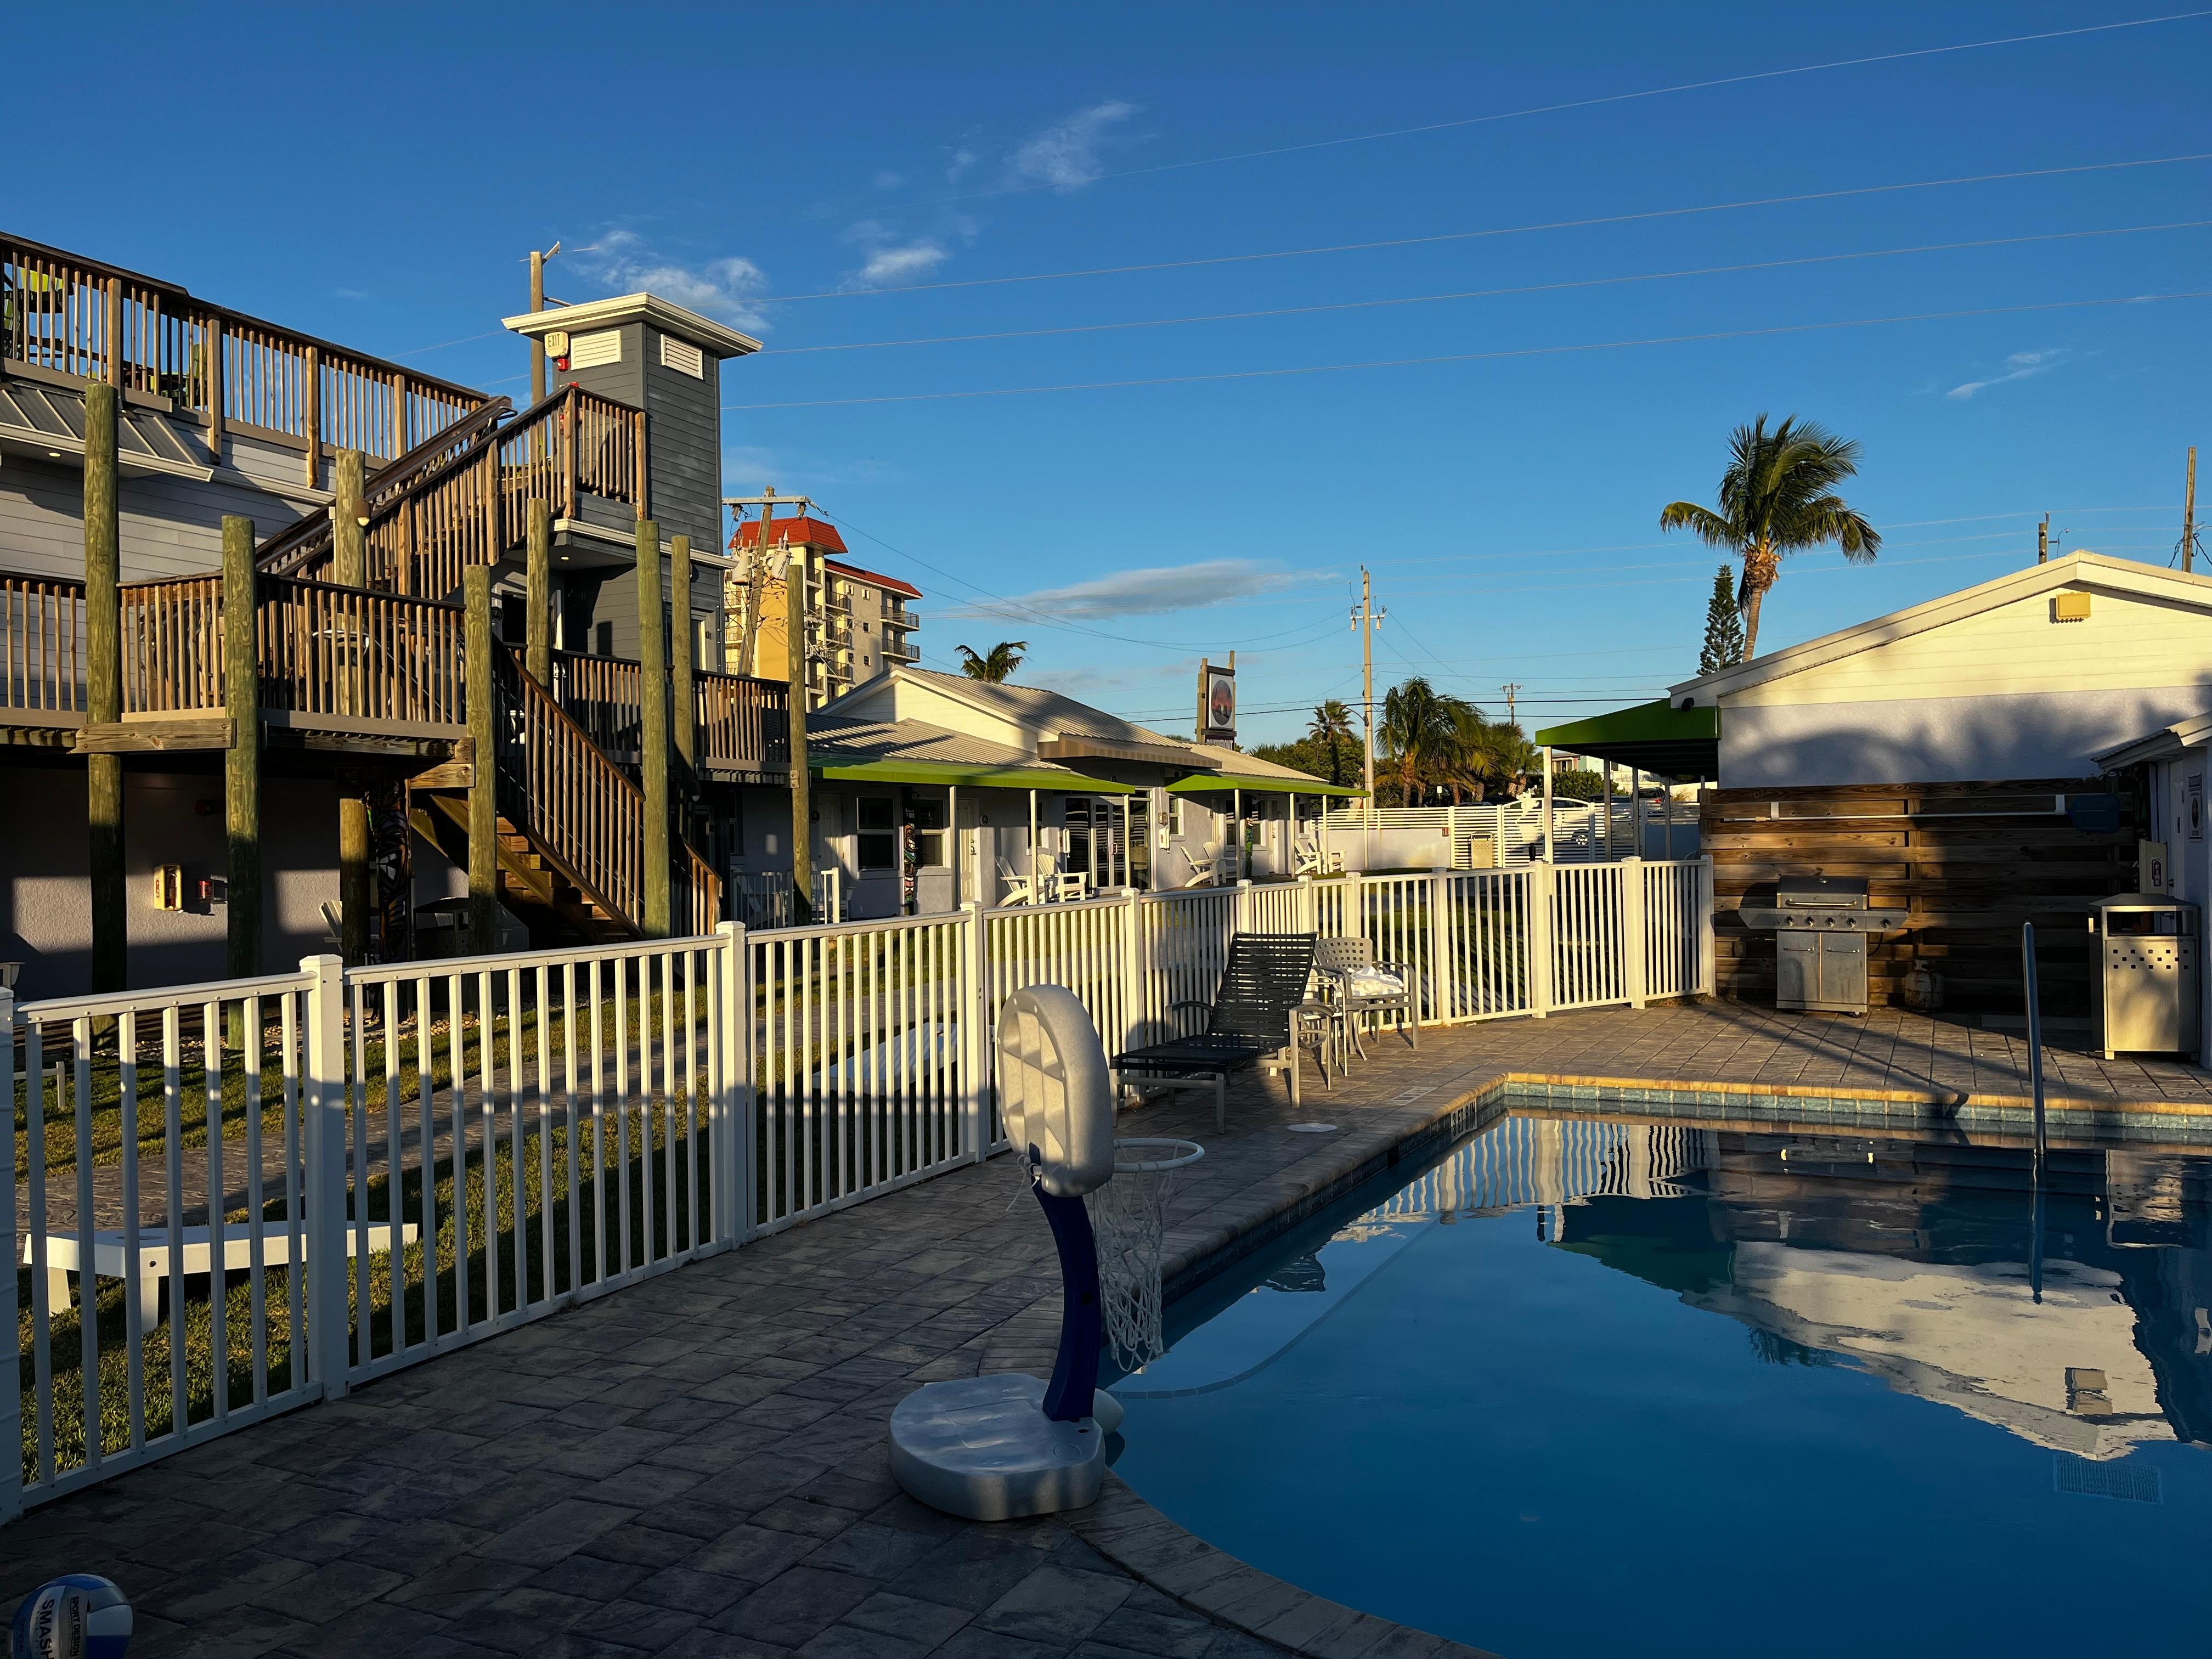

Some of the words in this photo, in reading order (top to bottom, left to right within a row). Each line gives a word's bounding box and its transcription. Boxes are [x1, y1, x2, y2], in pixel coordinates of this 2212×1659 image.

[548, 334, 560, 347] EXIT
[72, 1595, 80, 1622] SPORT
[39, 1599, 55, 1659] SMASH
[71, 1623, 81, 1657] DESIGN
